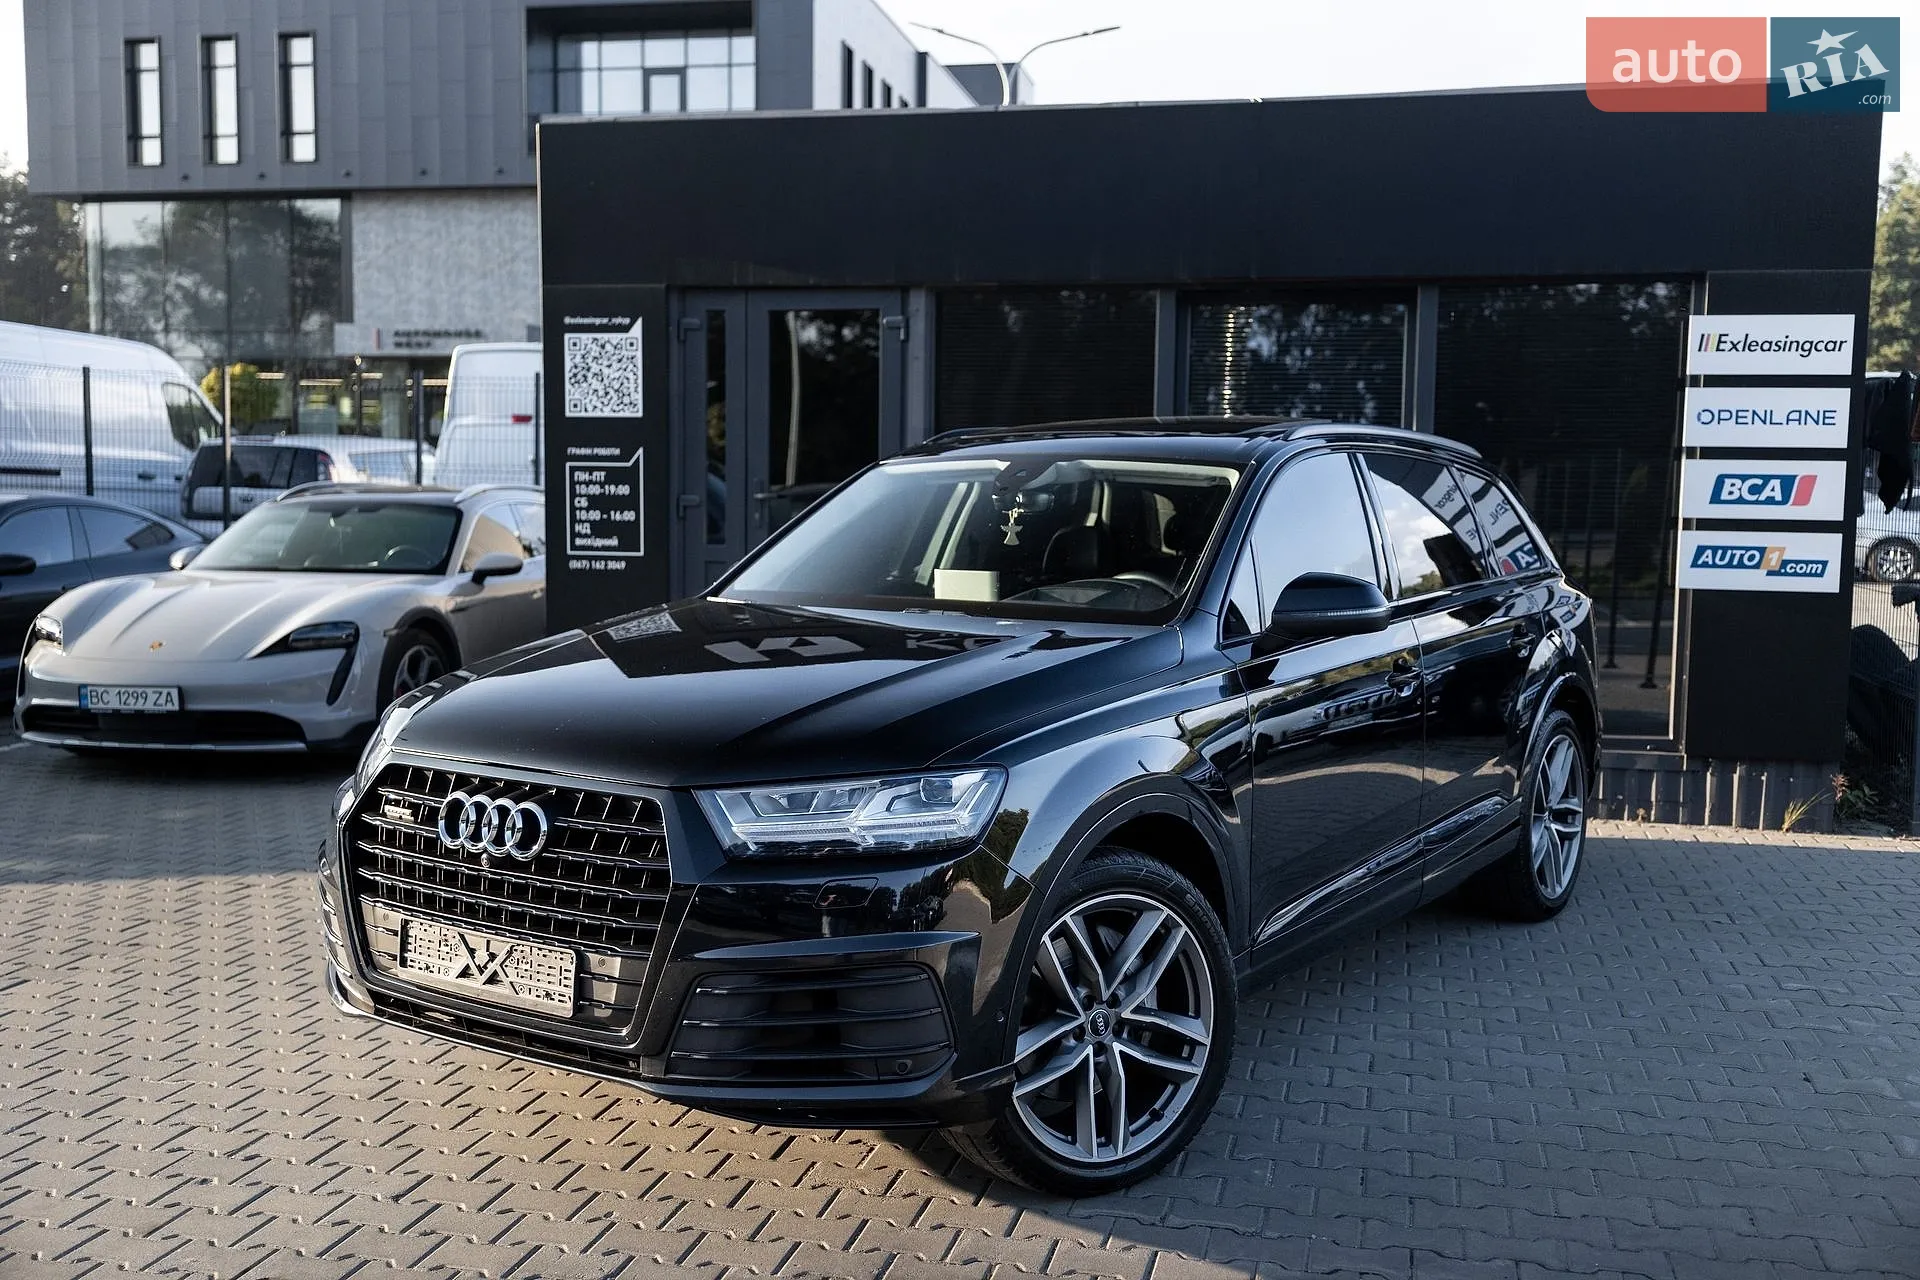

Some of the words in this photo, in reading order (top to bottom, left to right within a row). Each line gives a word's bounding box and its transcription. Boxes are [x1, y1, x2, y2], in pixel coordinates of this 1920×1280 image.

[1715, 333, 1848, 358] Exleasingcar
[1697, 409, 1837, 426] OPENLANE
[574, 471, 607, 482] ПН-ПТ
[575, 484, 631, 496] 10:00-19:00
[1720, 478, 1783, 501] BCA
[574, 496, 589, 508] СБ
[575, 509, 601, 521] 10:00
[610, 510, 636, 521] 16:00
[574, 522, 591, 535] НД
[89, 690, 111, 706] BC
[115, 690, 148, 707] 1299
[152, 690, 175, 707] ZA
